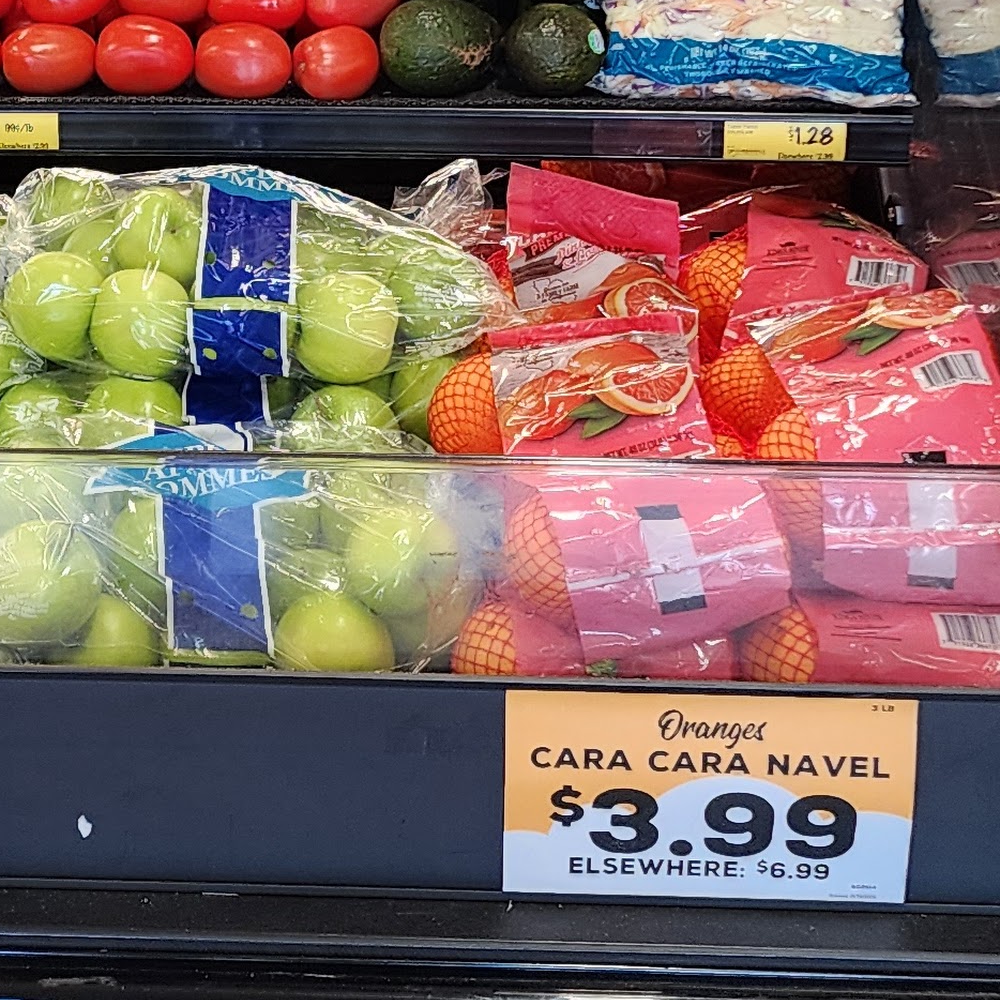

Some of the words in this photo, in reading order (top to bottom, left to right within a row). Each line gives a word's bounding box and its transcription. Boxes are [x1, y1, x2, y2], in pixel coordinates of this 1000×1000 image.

[788, 126, 834, 146] $1.28
[156, 467, 278, 500] OMMES
[871, 704, 879, 712] 3
[881, 704, 895, 712] LB
[657, 709, 768, 749] Oranges
[530, 746, 632, 772] CARA
[648, 750, 750, 775] CARA
[767, 753, 890, 779] NAVEL
[550, 785, 858, 861] $3.99
[569, 856, 745, 879] ELSEWHERE:
[757, 859, 830, 880] $6.99
